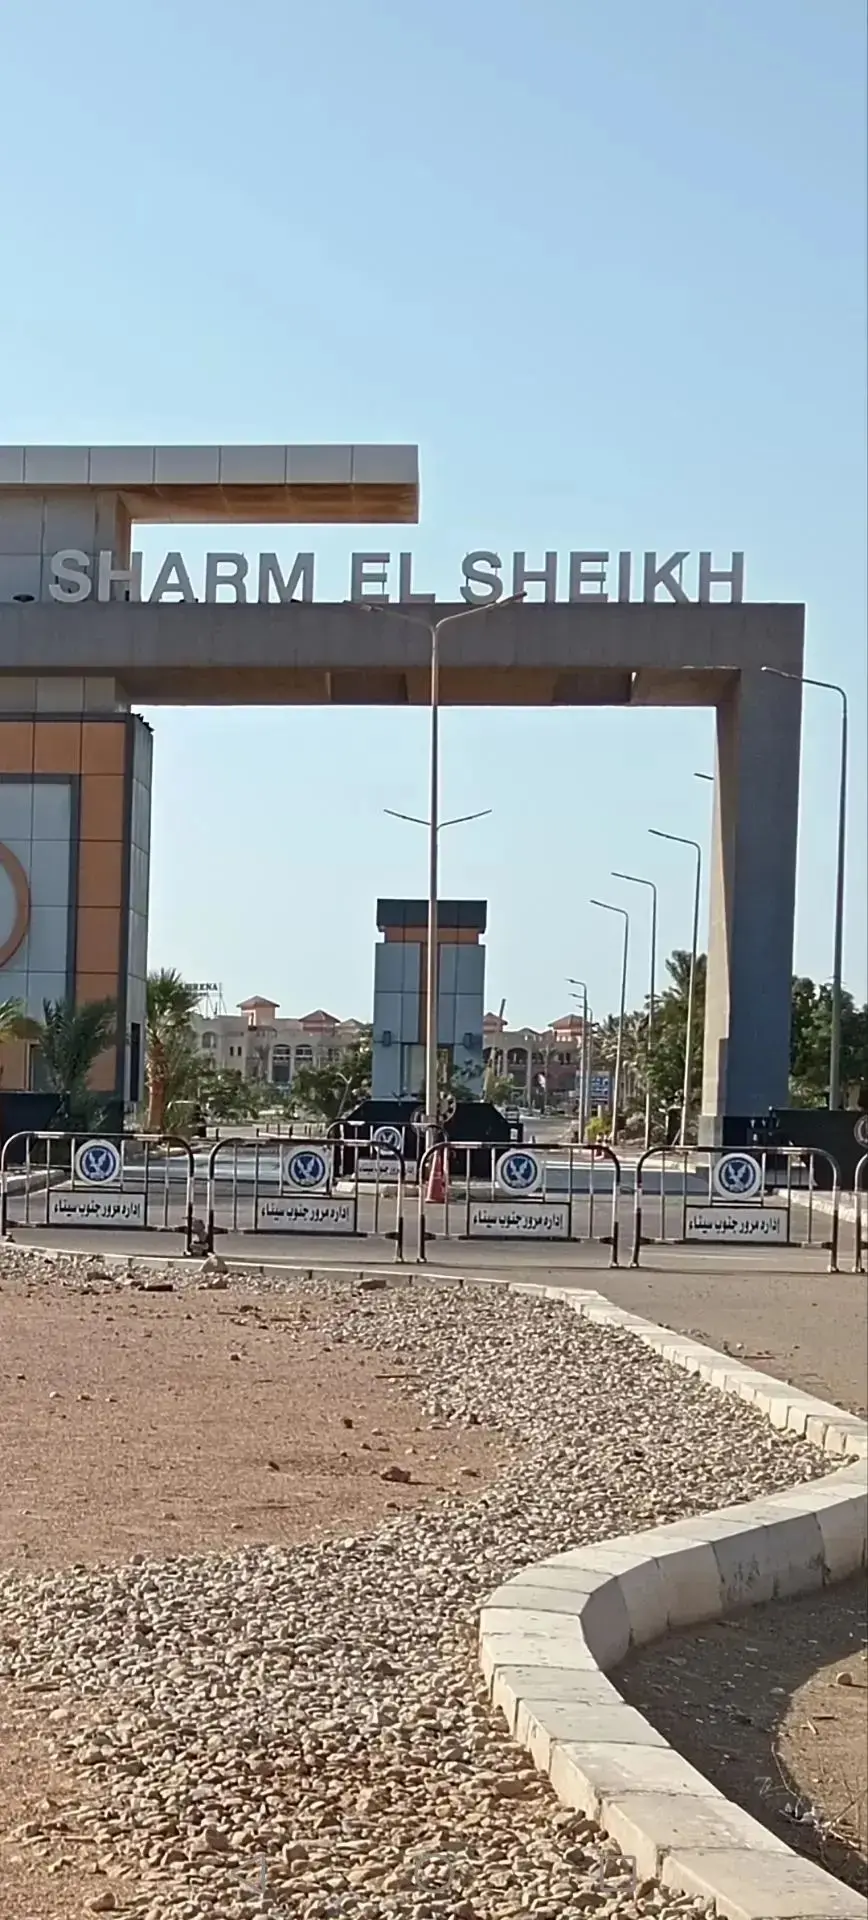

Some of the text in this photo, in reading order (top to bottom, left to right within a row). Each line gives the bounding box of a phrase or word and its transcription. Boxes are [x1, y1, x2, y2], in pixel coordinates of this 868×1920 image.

[49, 549, 744, 604] SHARM EL SHEIKH
[55, 1199, 77, 1217] سيناء
[78, 1200, 100, 1217] جنوب
[101, 1204, 121, 1218] مرور
[262, 1203, 284, 1221] سيناء
[286, 1203, 309, 1221] جنوب
[310, 1208, 329, 1221] مرور
[473, 1209, 496, 1228] سيناء
[499, 1211, 521, 1229] جنوب
[522, 1216, 542, 1229] مرور
[689, 1216, 713, 1234] سيناء
[715, 1216, 738, 1234] جنوب
[739, 1220, 759, 1234] مرور
